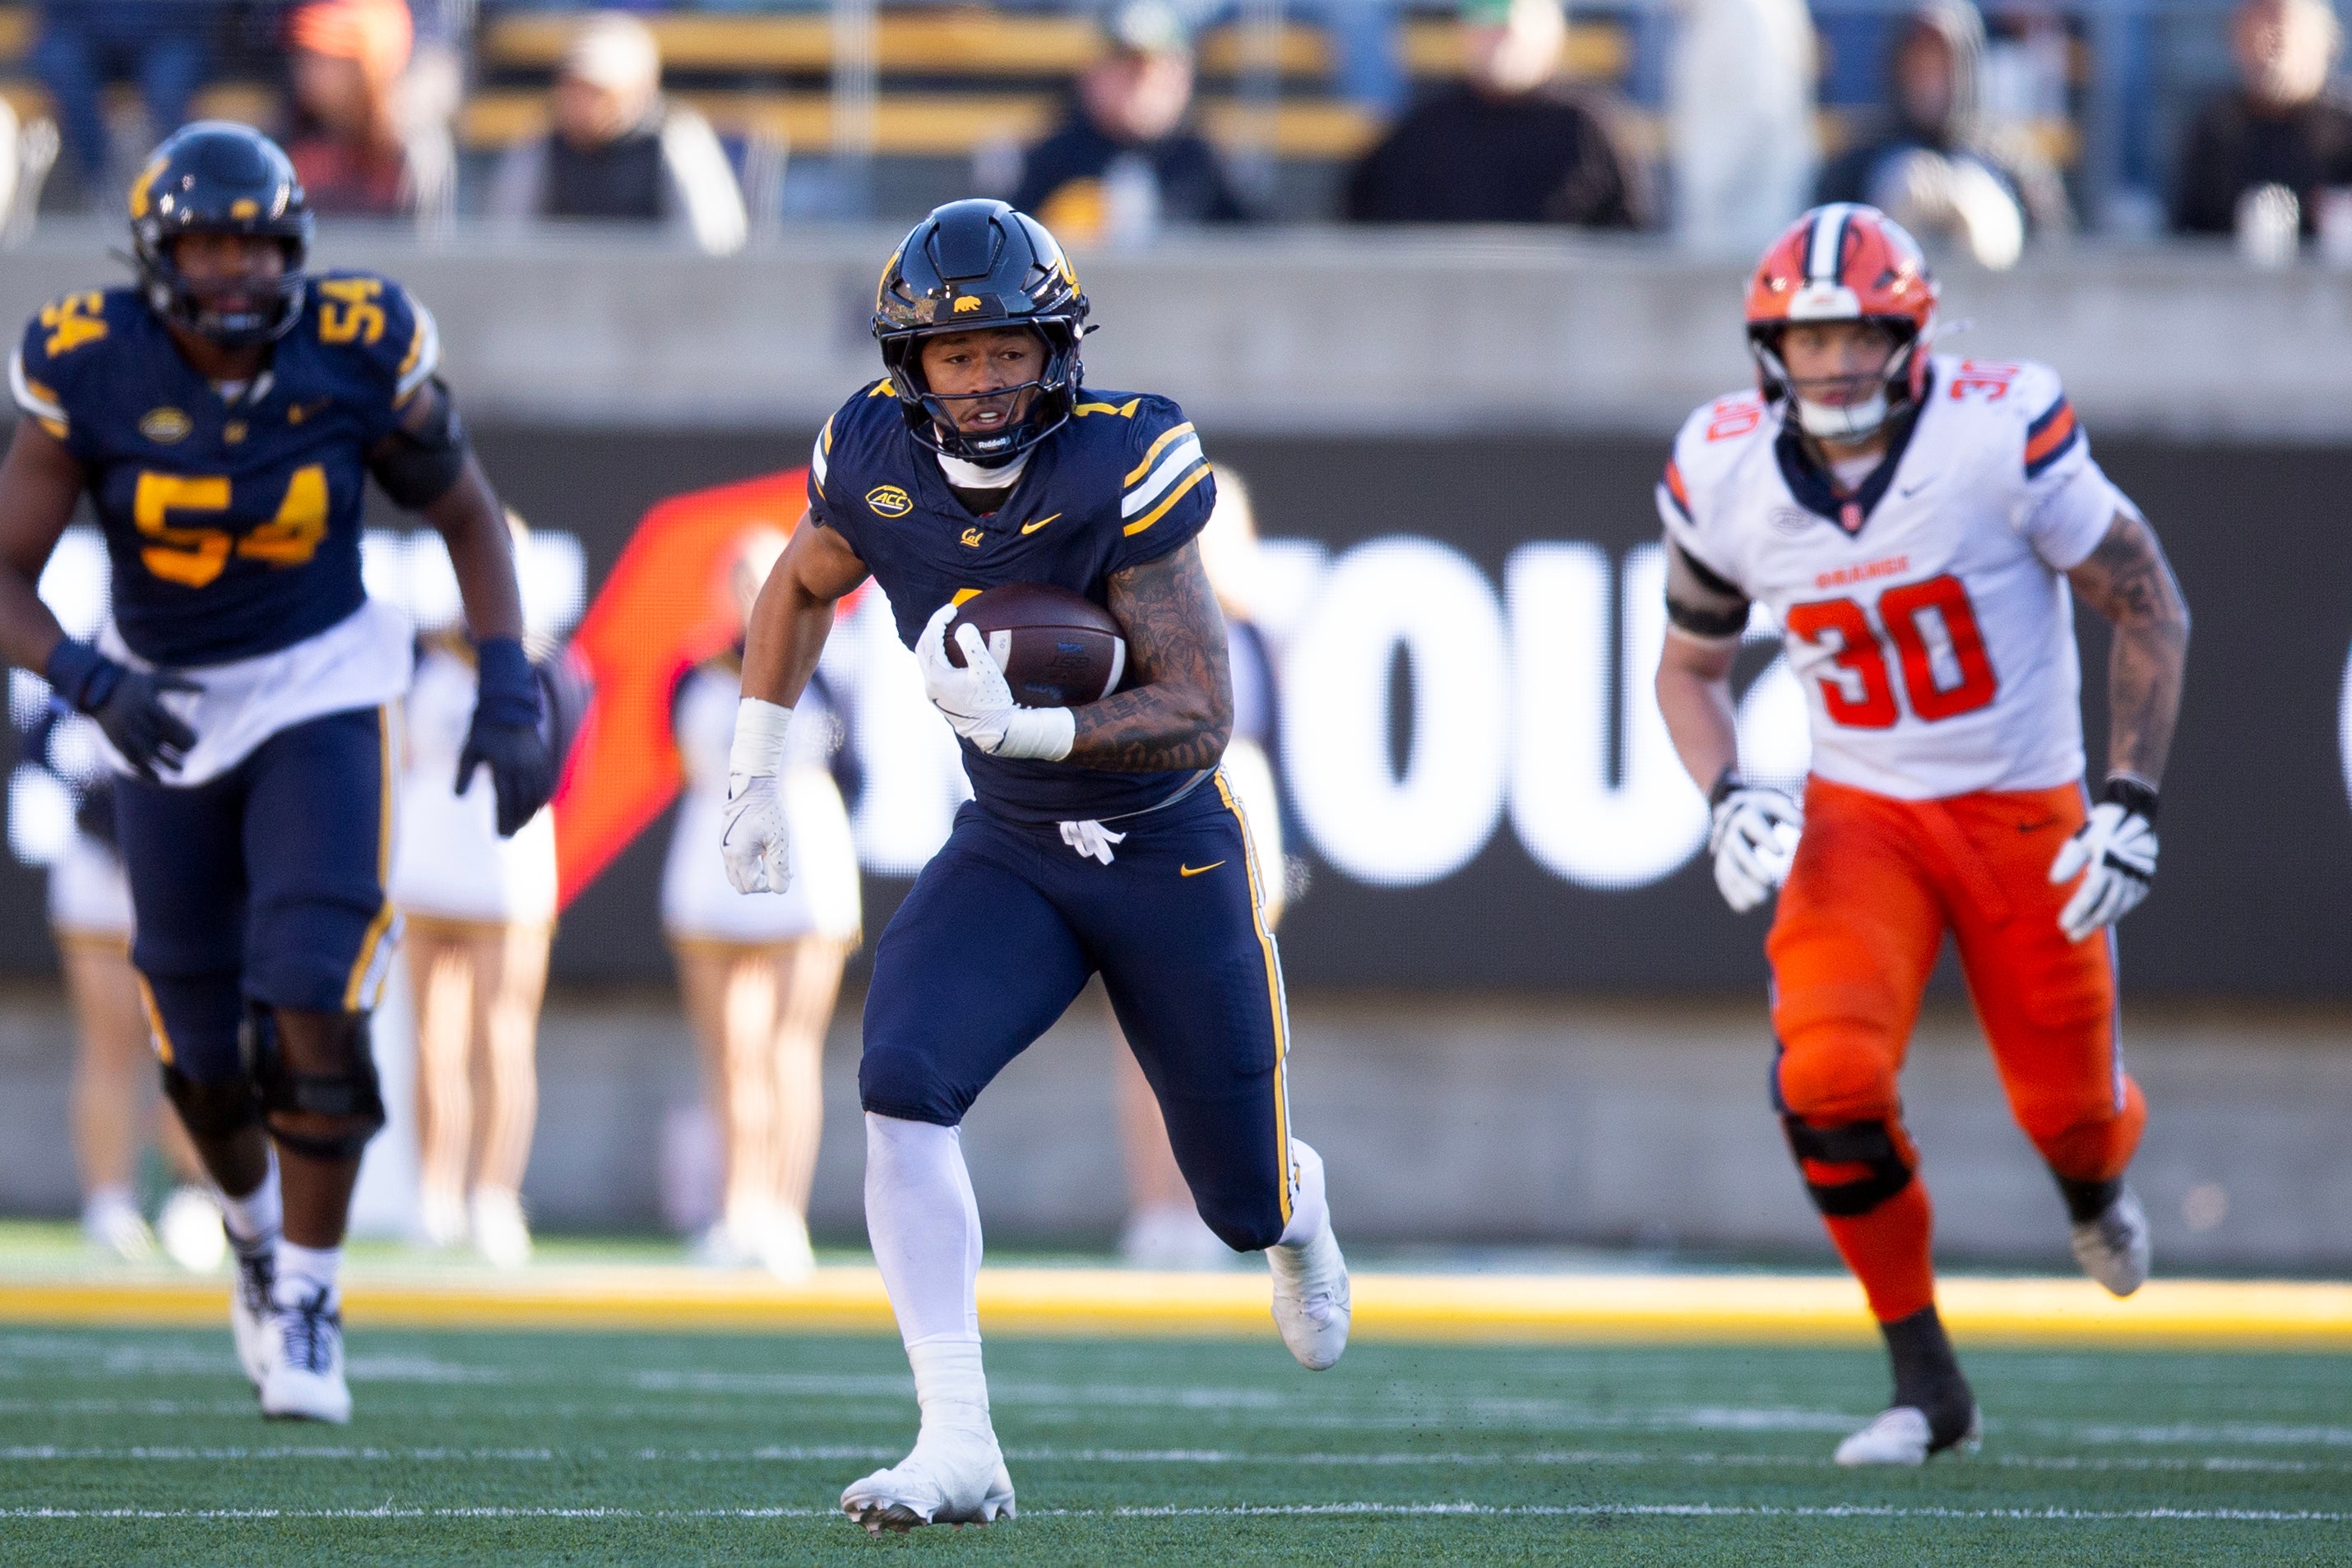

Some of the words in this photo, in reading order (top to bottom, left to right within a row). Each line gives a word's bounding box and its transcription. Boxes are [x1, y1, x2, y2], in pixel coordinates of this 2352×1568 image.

[978, 437, 1006, 449] Riddell
[872, 492, 908, 508] ACC
[134, 464, 327, 588] 54
[960, 527, 984, 548] Cal
[1814, 556, 1908, 590] ORANGE
[1785, 573, 1999, 729] 30
